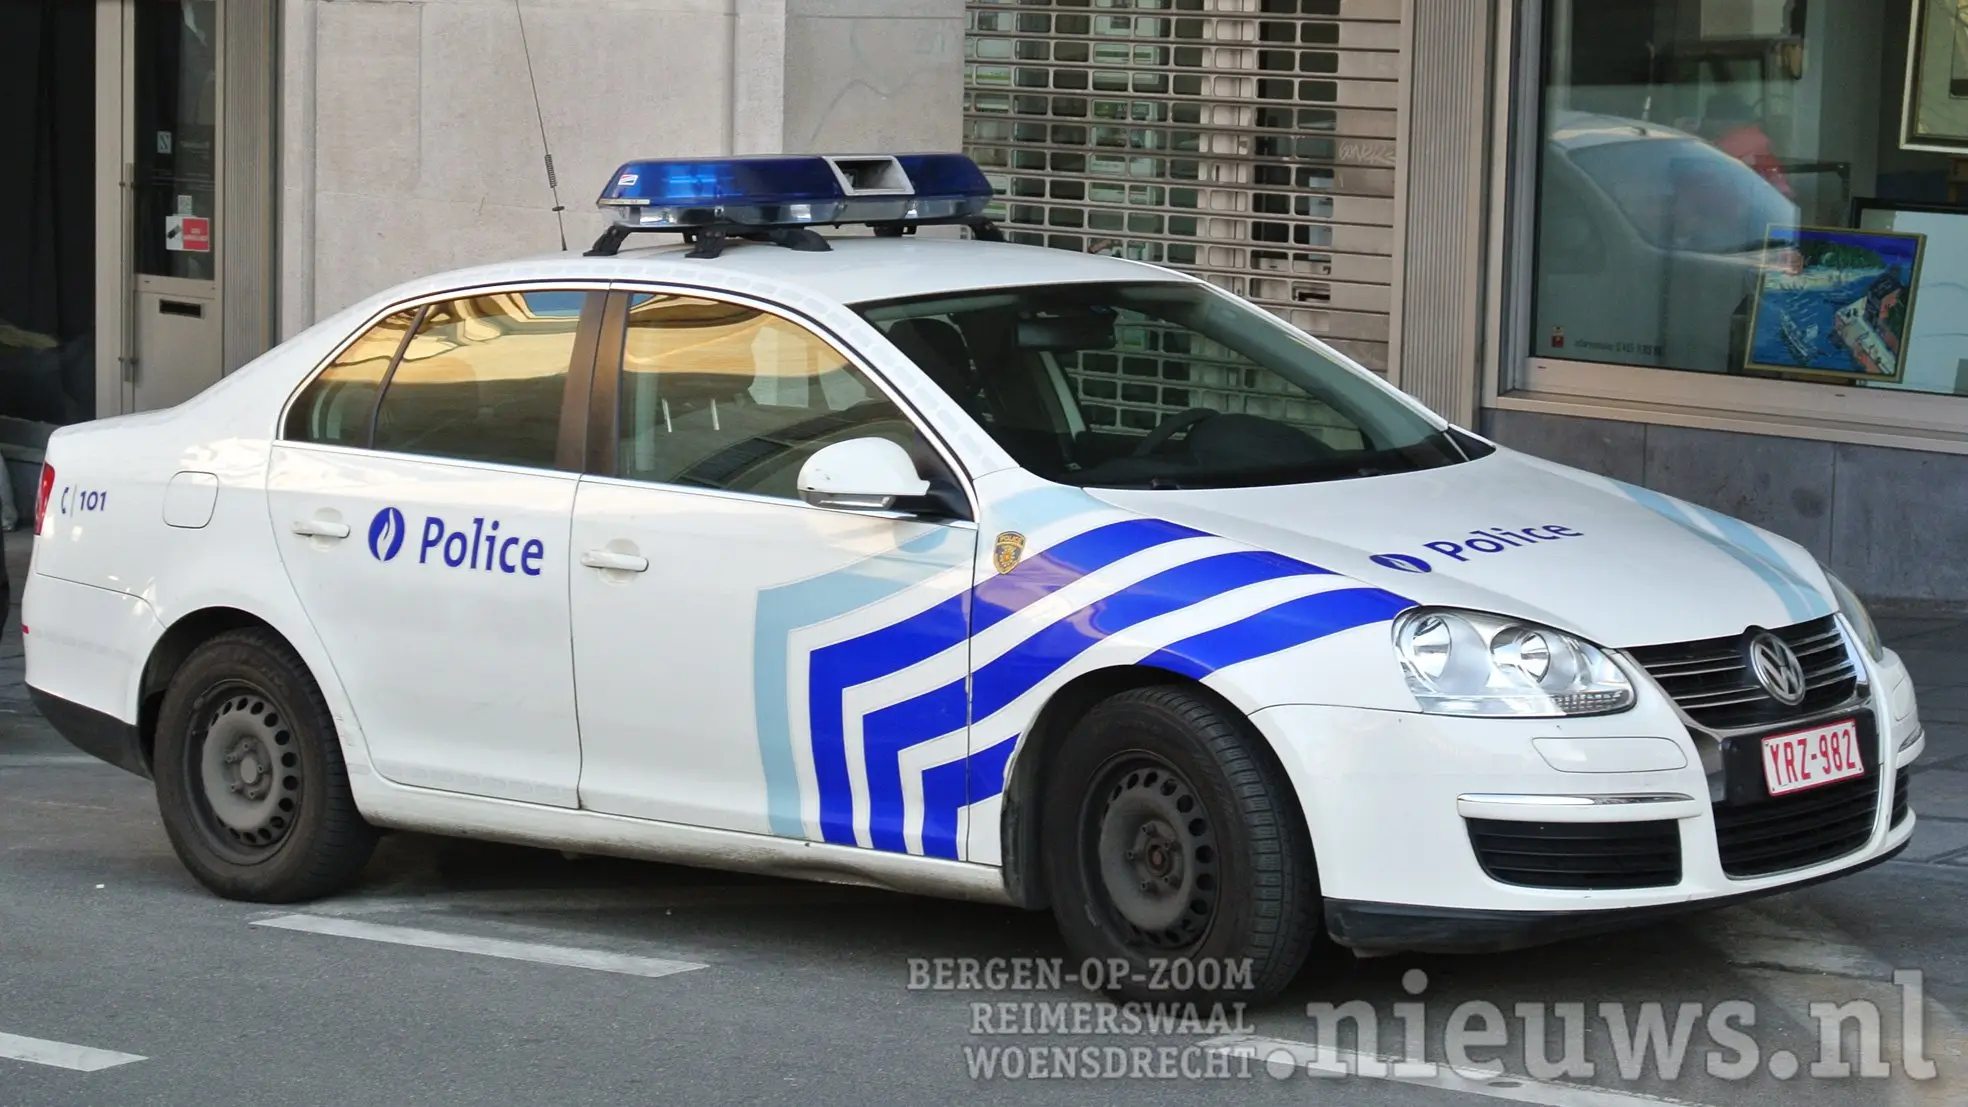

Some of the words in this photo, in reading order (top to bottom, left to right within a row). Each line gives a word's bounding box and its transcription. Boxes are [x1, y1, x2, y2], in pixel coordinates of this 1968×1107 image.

[80, 490, 107, 511] 101
[419, 516, 544, 576] Police
[1423, 525, 1584, 561] Police
[1770, 729, 1856, 786] YRZ-982
